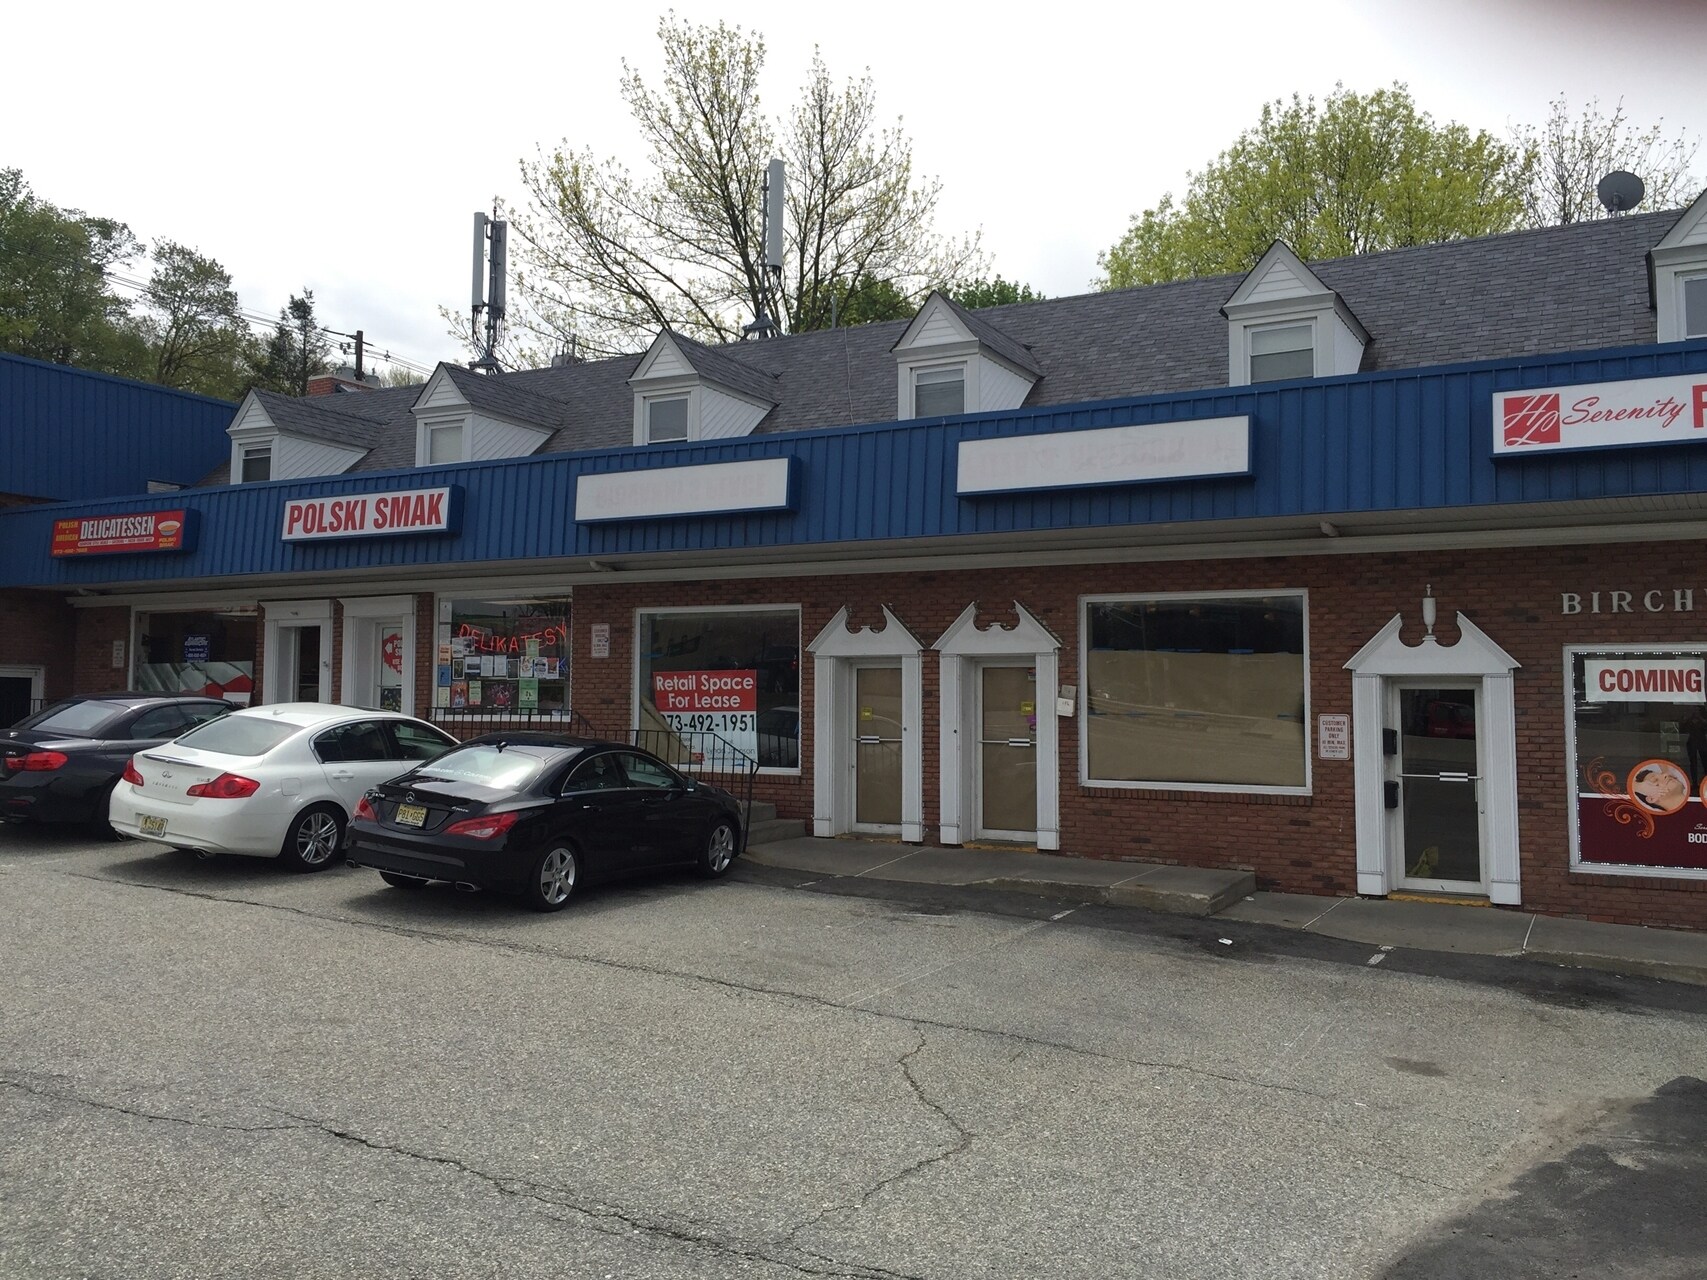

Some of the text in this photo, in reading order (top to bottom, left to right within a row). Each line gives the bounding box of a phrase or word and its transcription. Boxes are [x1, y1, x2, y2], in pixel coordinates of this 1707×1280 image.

[1562, 396, 1687, 429] Serenity
[287, 493, 444, 535] POLSKI SMAK
[80, 516, 155, 540] DELICATESSEN
[1561, 588, 1707, 615] BIRCH
[656, 674, 754, 693] Retail Space
[1599, 668, 1702, 693] COMING
[668, 692, 741, 708] For Lease
[661, 714, 755, 732] 73-492-1951
